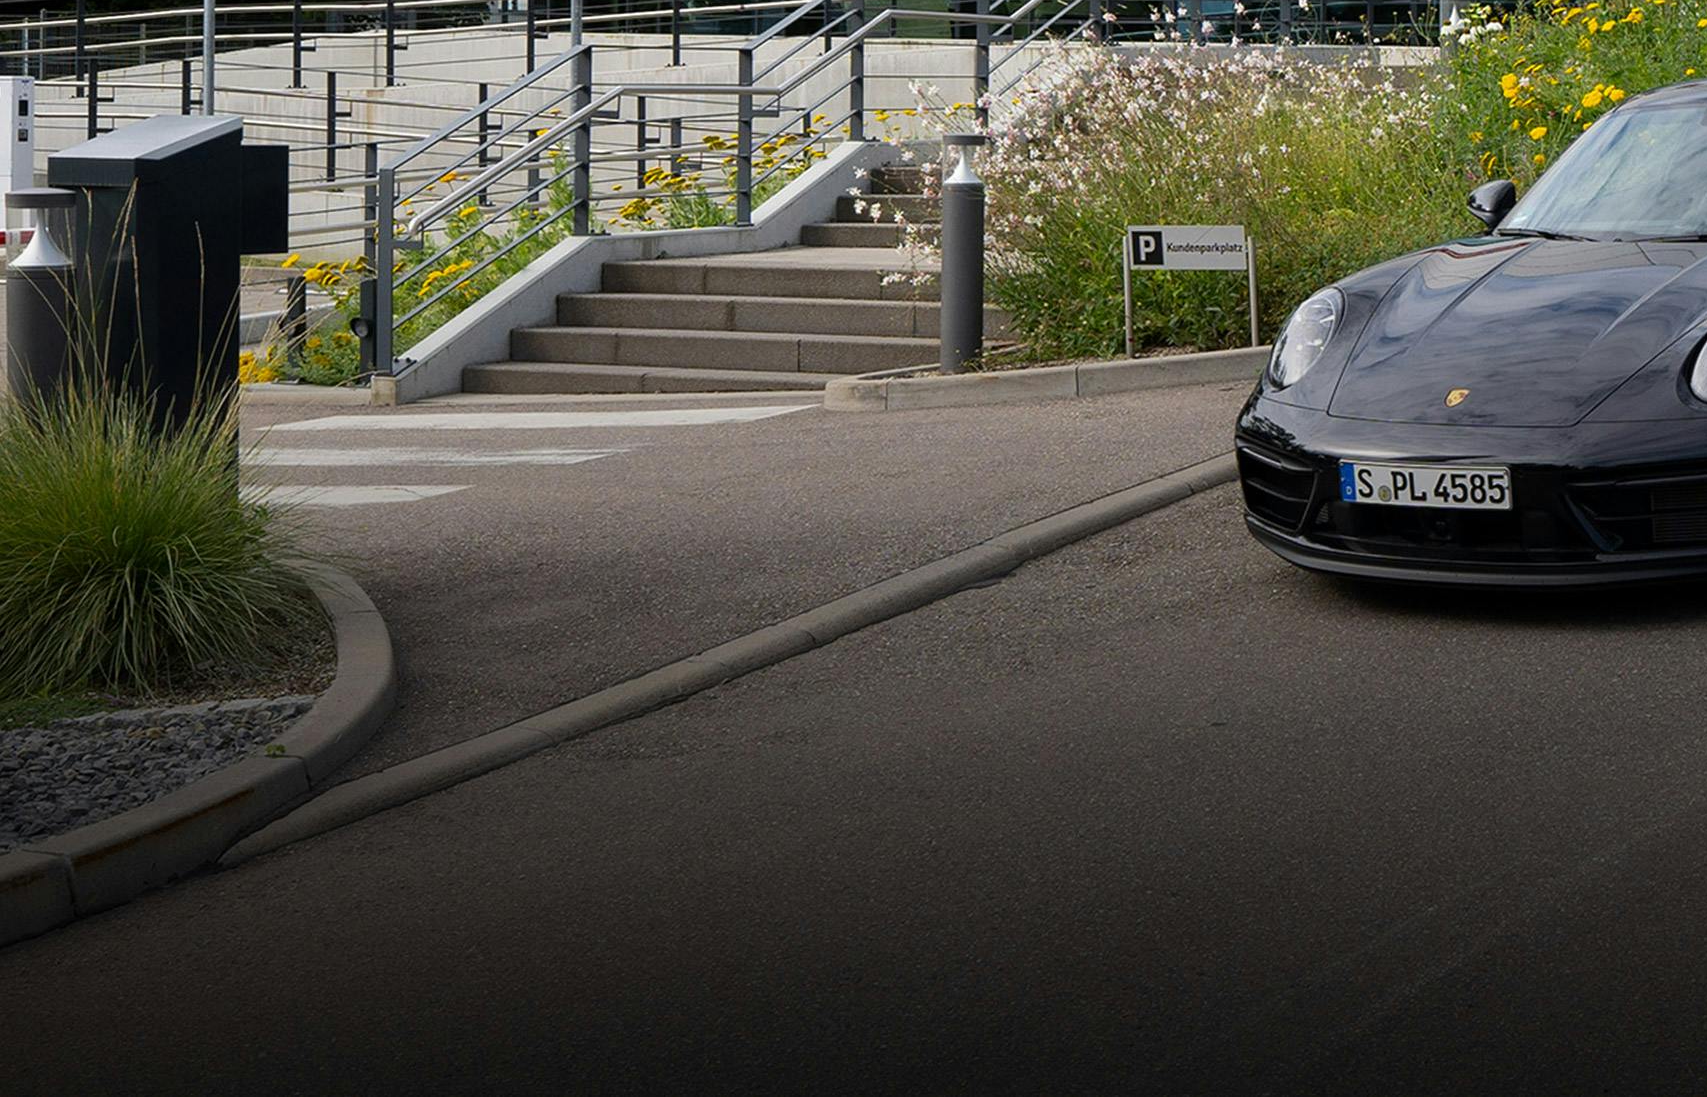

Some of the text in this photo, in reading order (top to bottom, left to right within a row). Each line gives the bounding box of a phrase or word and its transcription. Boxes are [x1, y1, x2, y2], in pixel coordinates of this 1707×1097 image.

[1138, 235, 1243, 261] P Kundenparkplatz
[1358, 469, 1374, 498] S
[1391, 471, 1427, 501] PL
[1434, 473, 1506, 504] 4585
